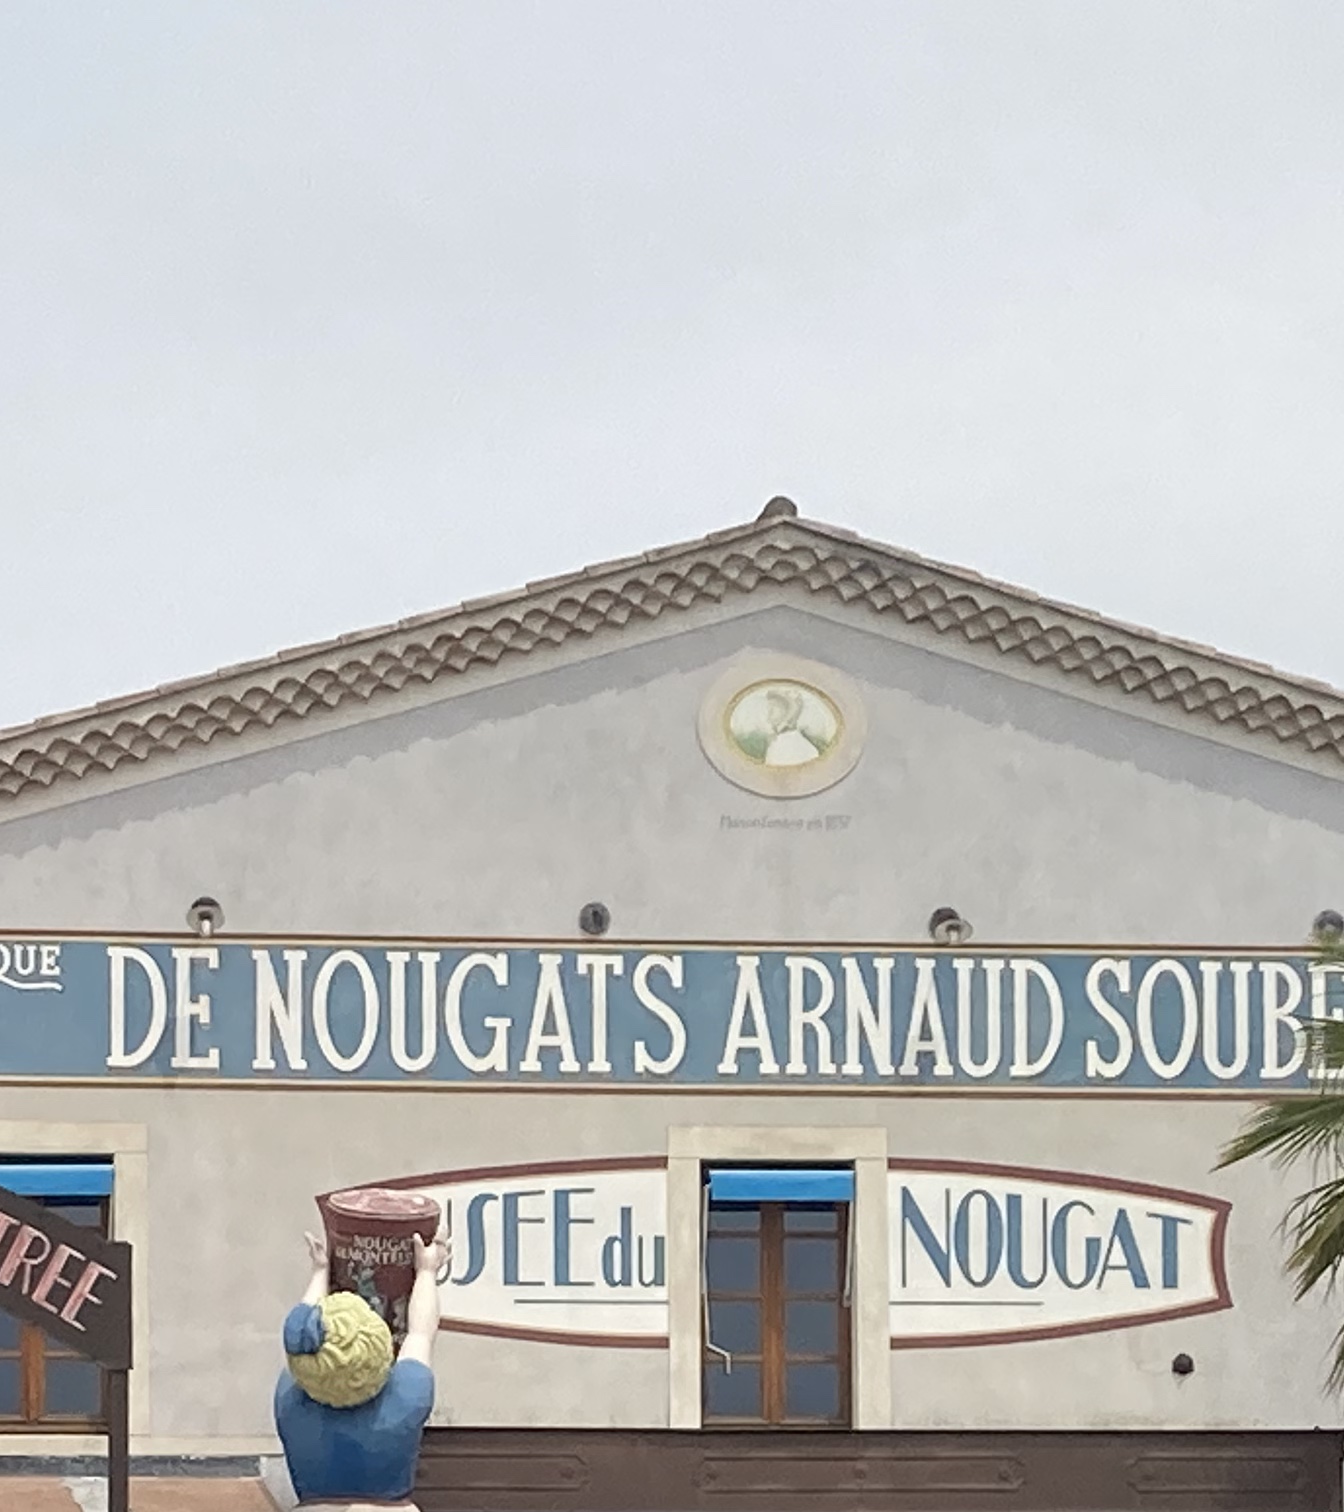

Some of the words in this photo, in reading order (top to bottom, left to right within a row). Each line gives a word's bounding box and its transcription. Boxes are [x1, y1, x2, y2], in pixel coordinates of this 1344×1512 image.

[106, 946, 220, 1069] DE
[251, 949, 686, 1074] NOUGATS
[717, 955, 1064, 1078] ARNAUD
[602, 1206, 665, 1288] du
[901, 1186, 1193, 1290] NOUGAT
